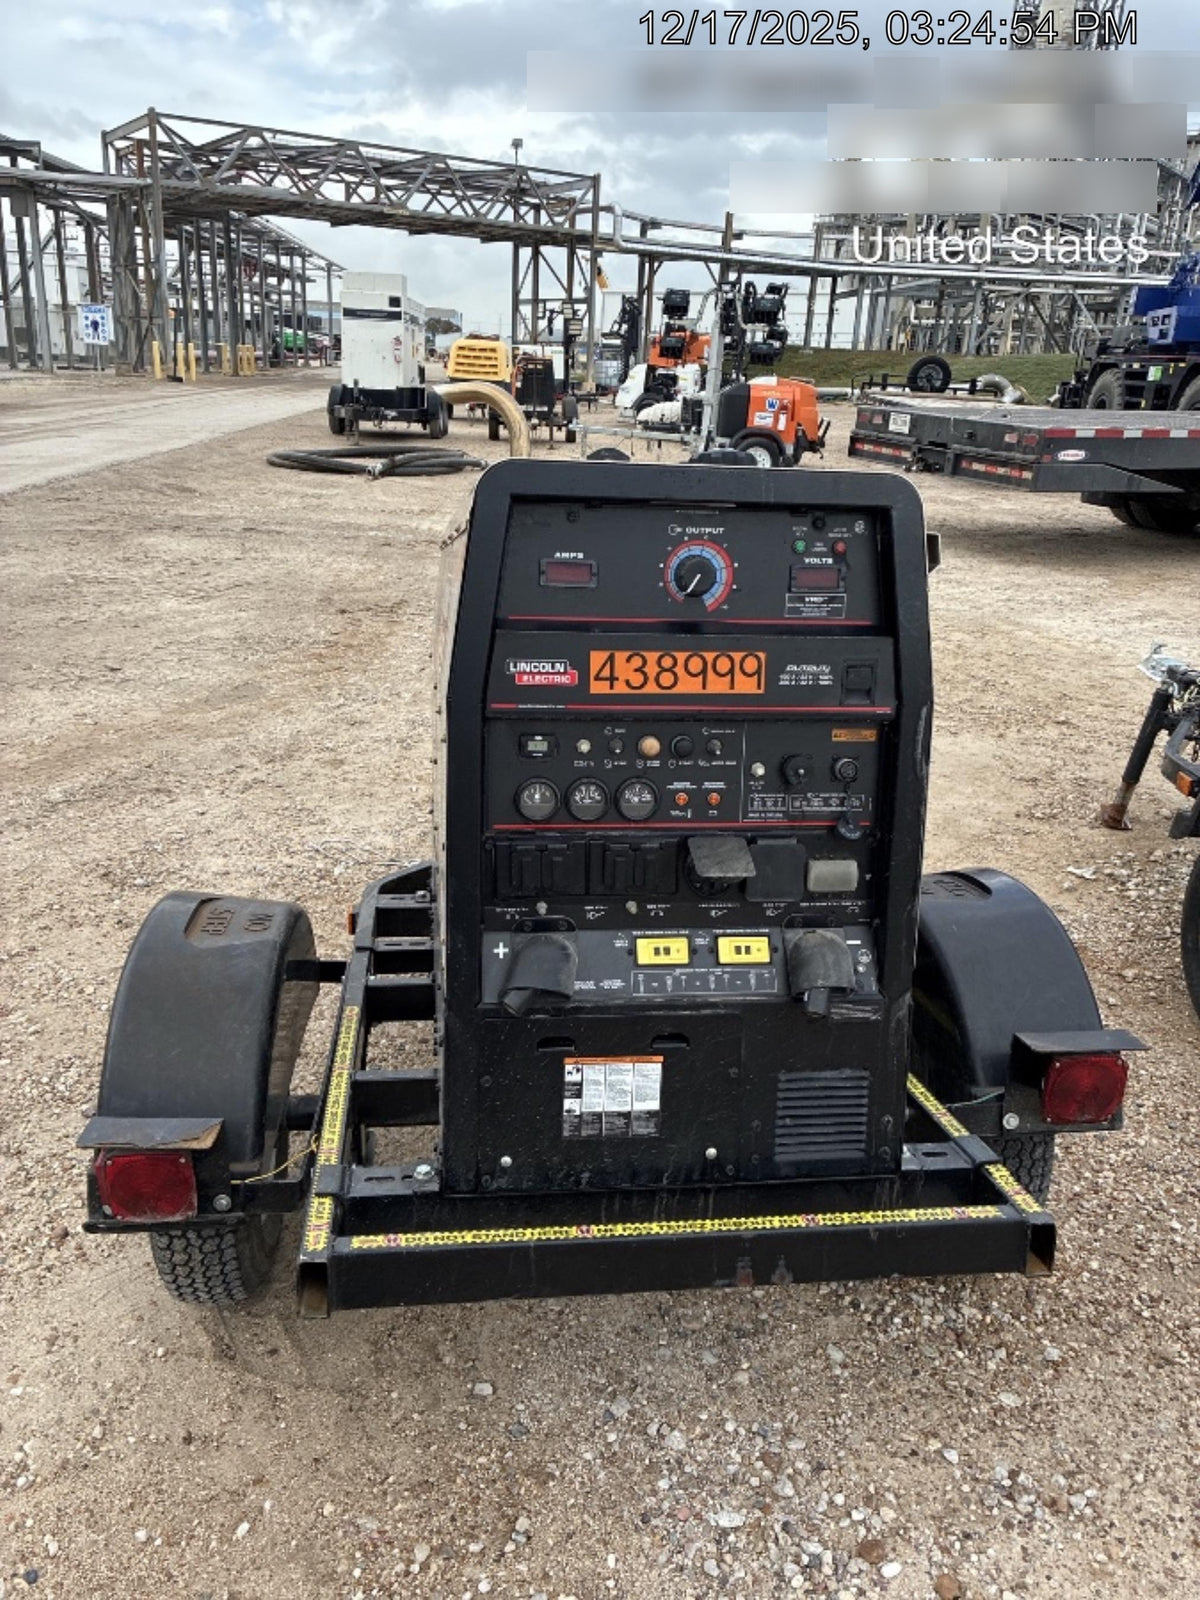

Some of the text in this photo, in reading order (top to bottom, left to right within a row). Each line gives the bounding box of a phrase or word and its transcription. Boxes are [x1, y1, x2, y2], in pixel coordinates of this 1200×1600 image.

[686, 526, 725, 535] OUTPUT
[803, 557, 834, 565] VOLTS
[509, 660, 566, 673] LINCOLN
[593, 652, 763, 690] 438999
[520, 674, 572, 684] ELECTRIC
[200, 908, 235, 936] STEP
[472, 1230, 526, 1241] STAND
